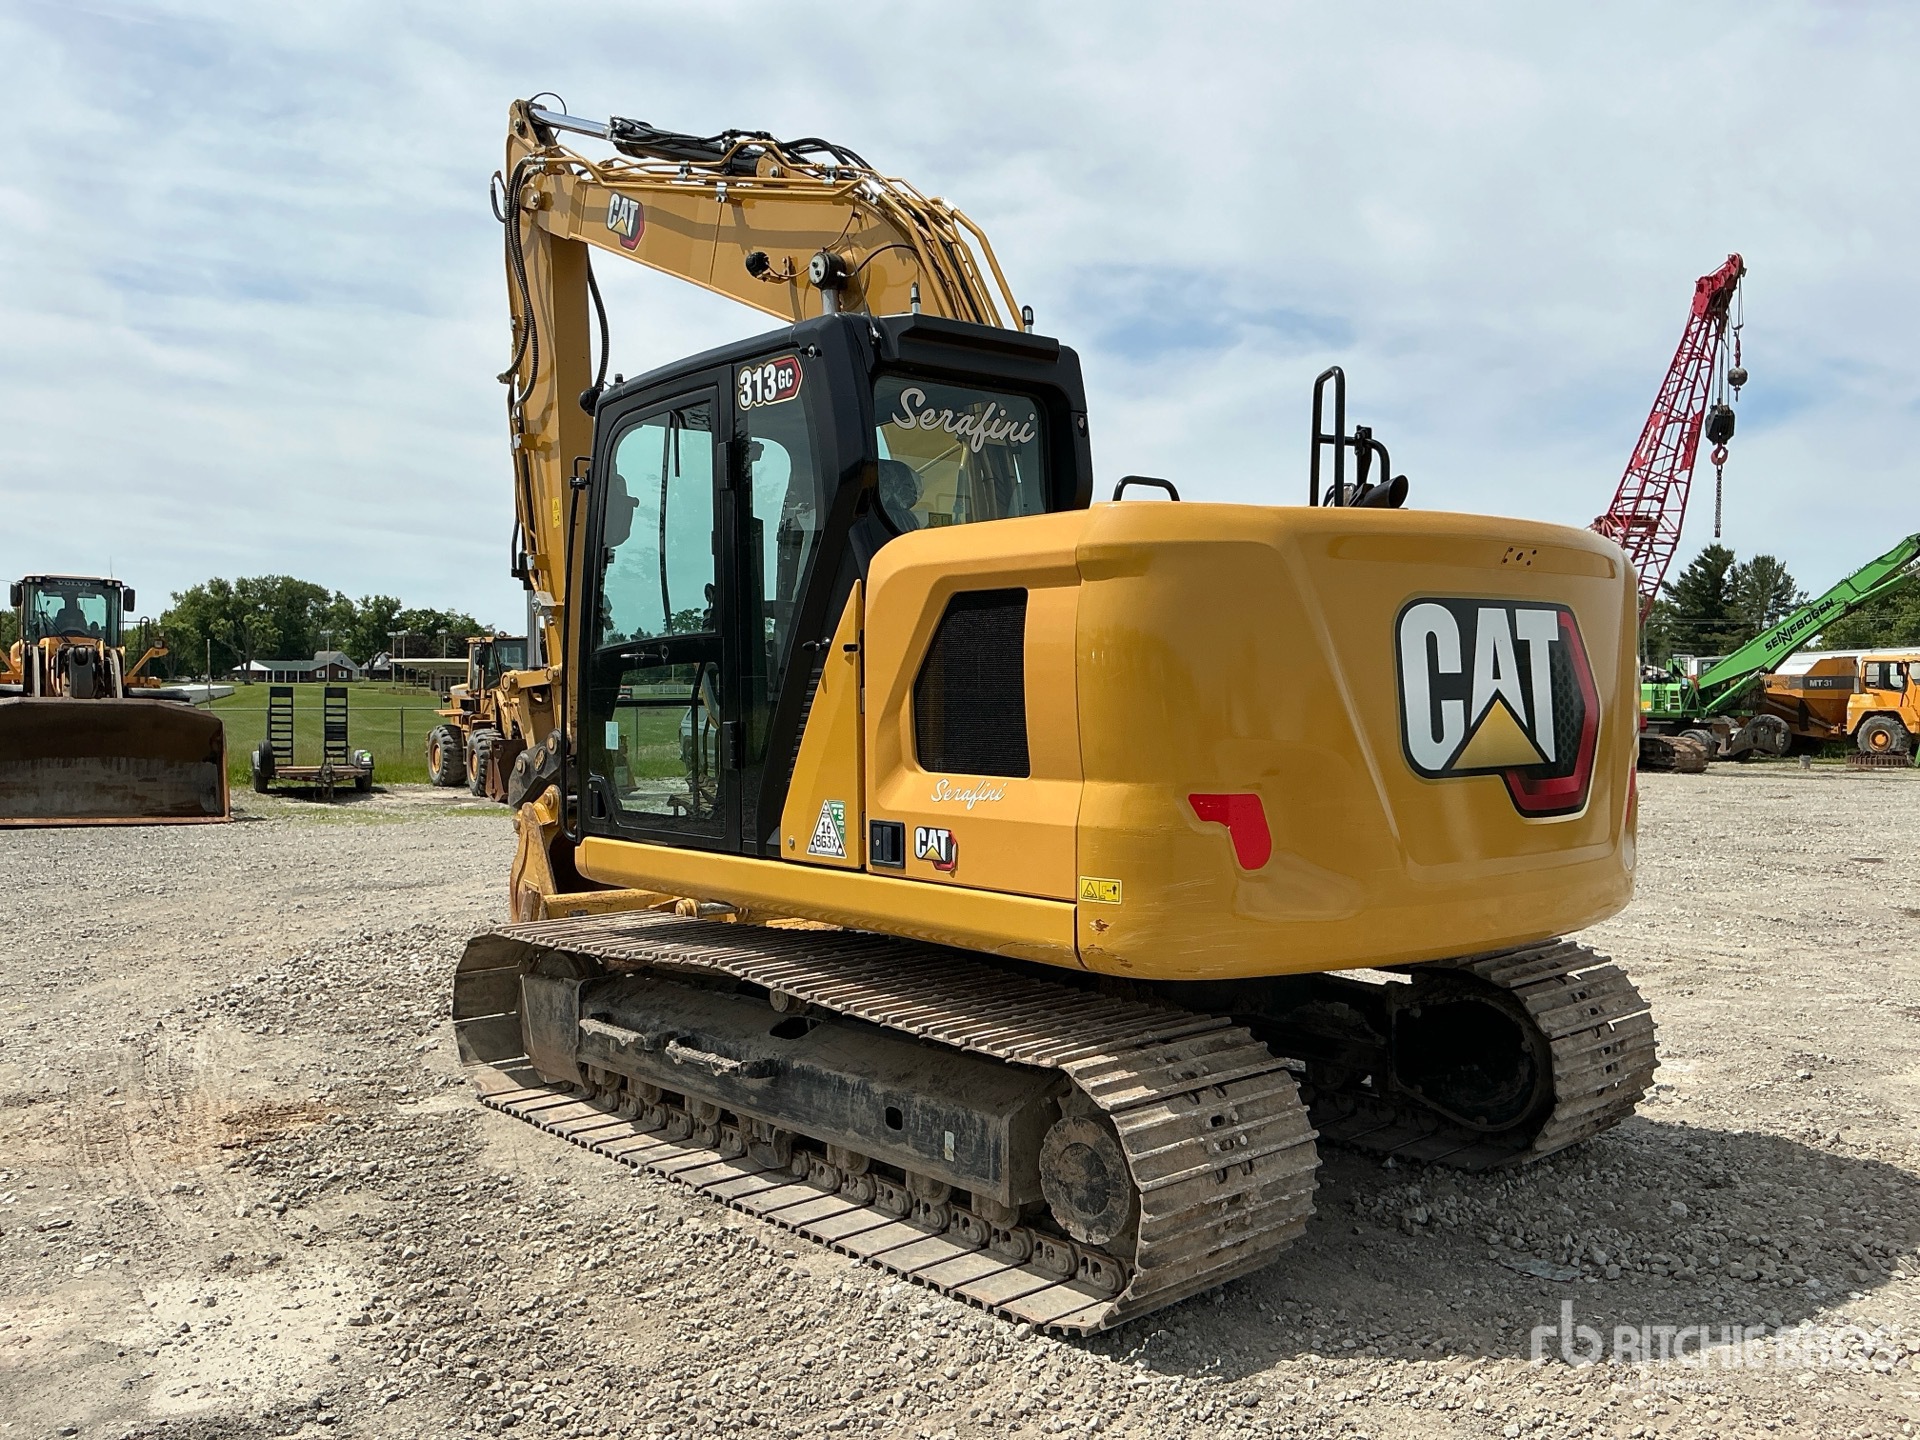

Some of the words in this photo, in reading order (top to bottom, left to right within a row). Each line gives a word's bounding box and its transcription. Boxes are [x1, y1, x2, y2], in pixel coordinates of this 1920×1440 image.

[608, 193, 639, 237] CAT
[892, 387, 1036, 453] Serafini
[1764, 597, 1836, 652] SENNEBOGEN
[1400, 602, 1560, 771] CAT
[1809, 679, 1823, 687] MT
[1823, 679, 1833, 687] 31
[930, 778, 1008, 811] Serafini
[821, 821, 831, 835] 16
[837, 808, 844, 820] 5
[915, 827, 949, 861] CAT
